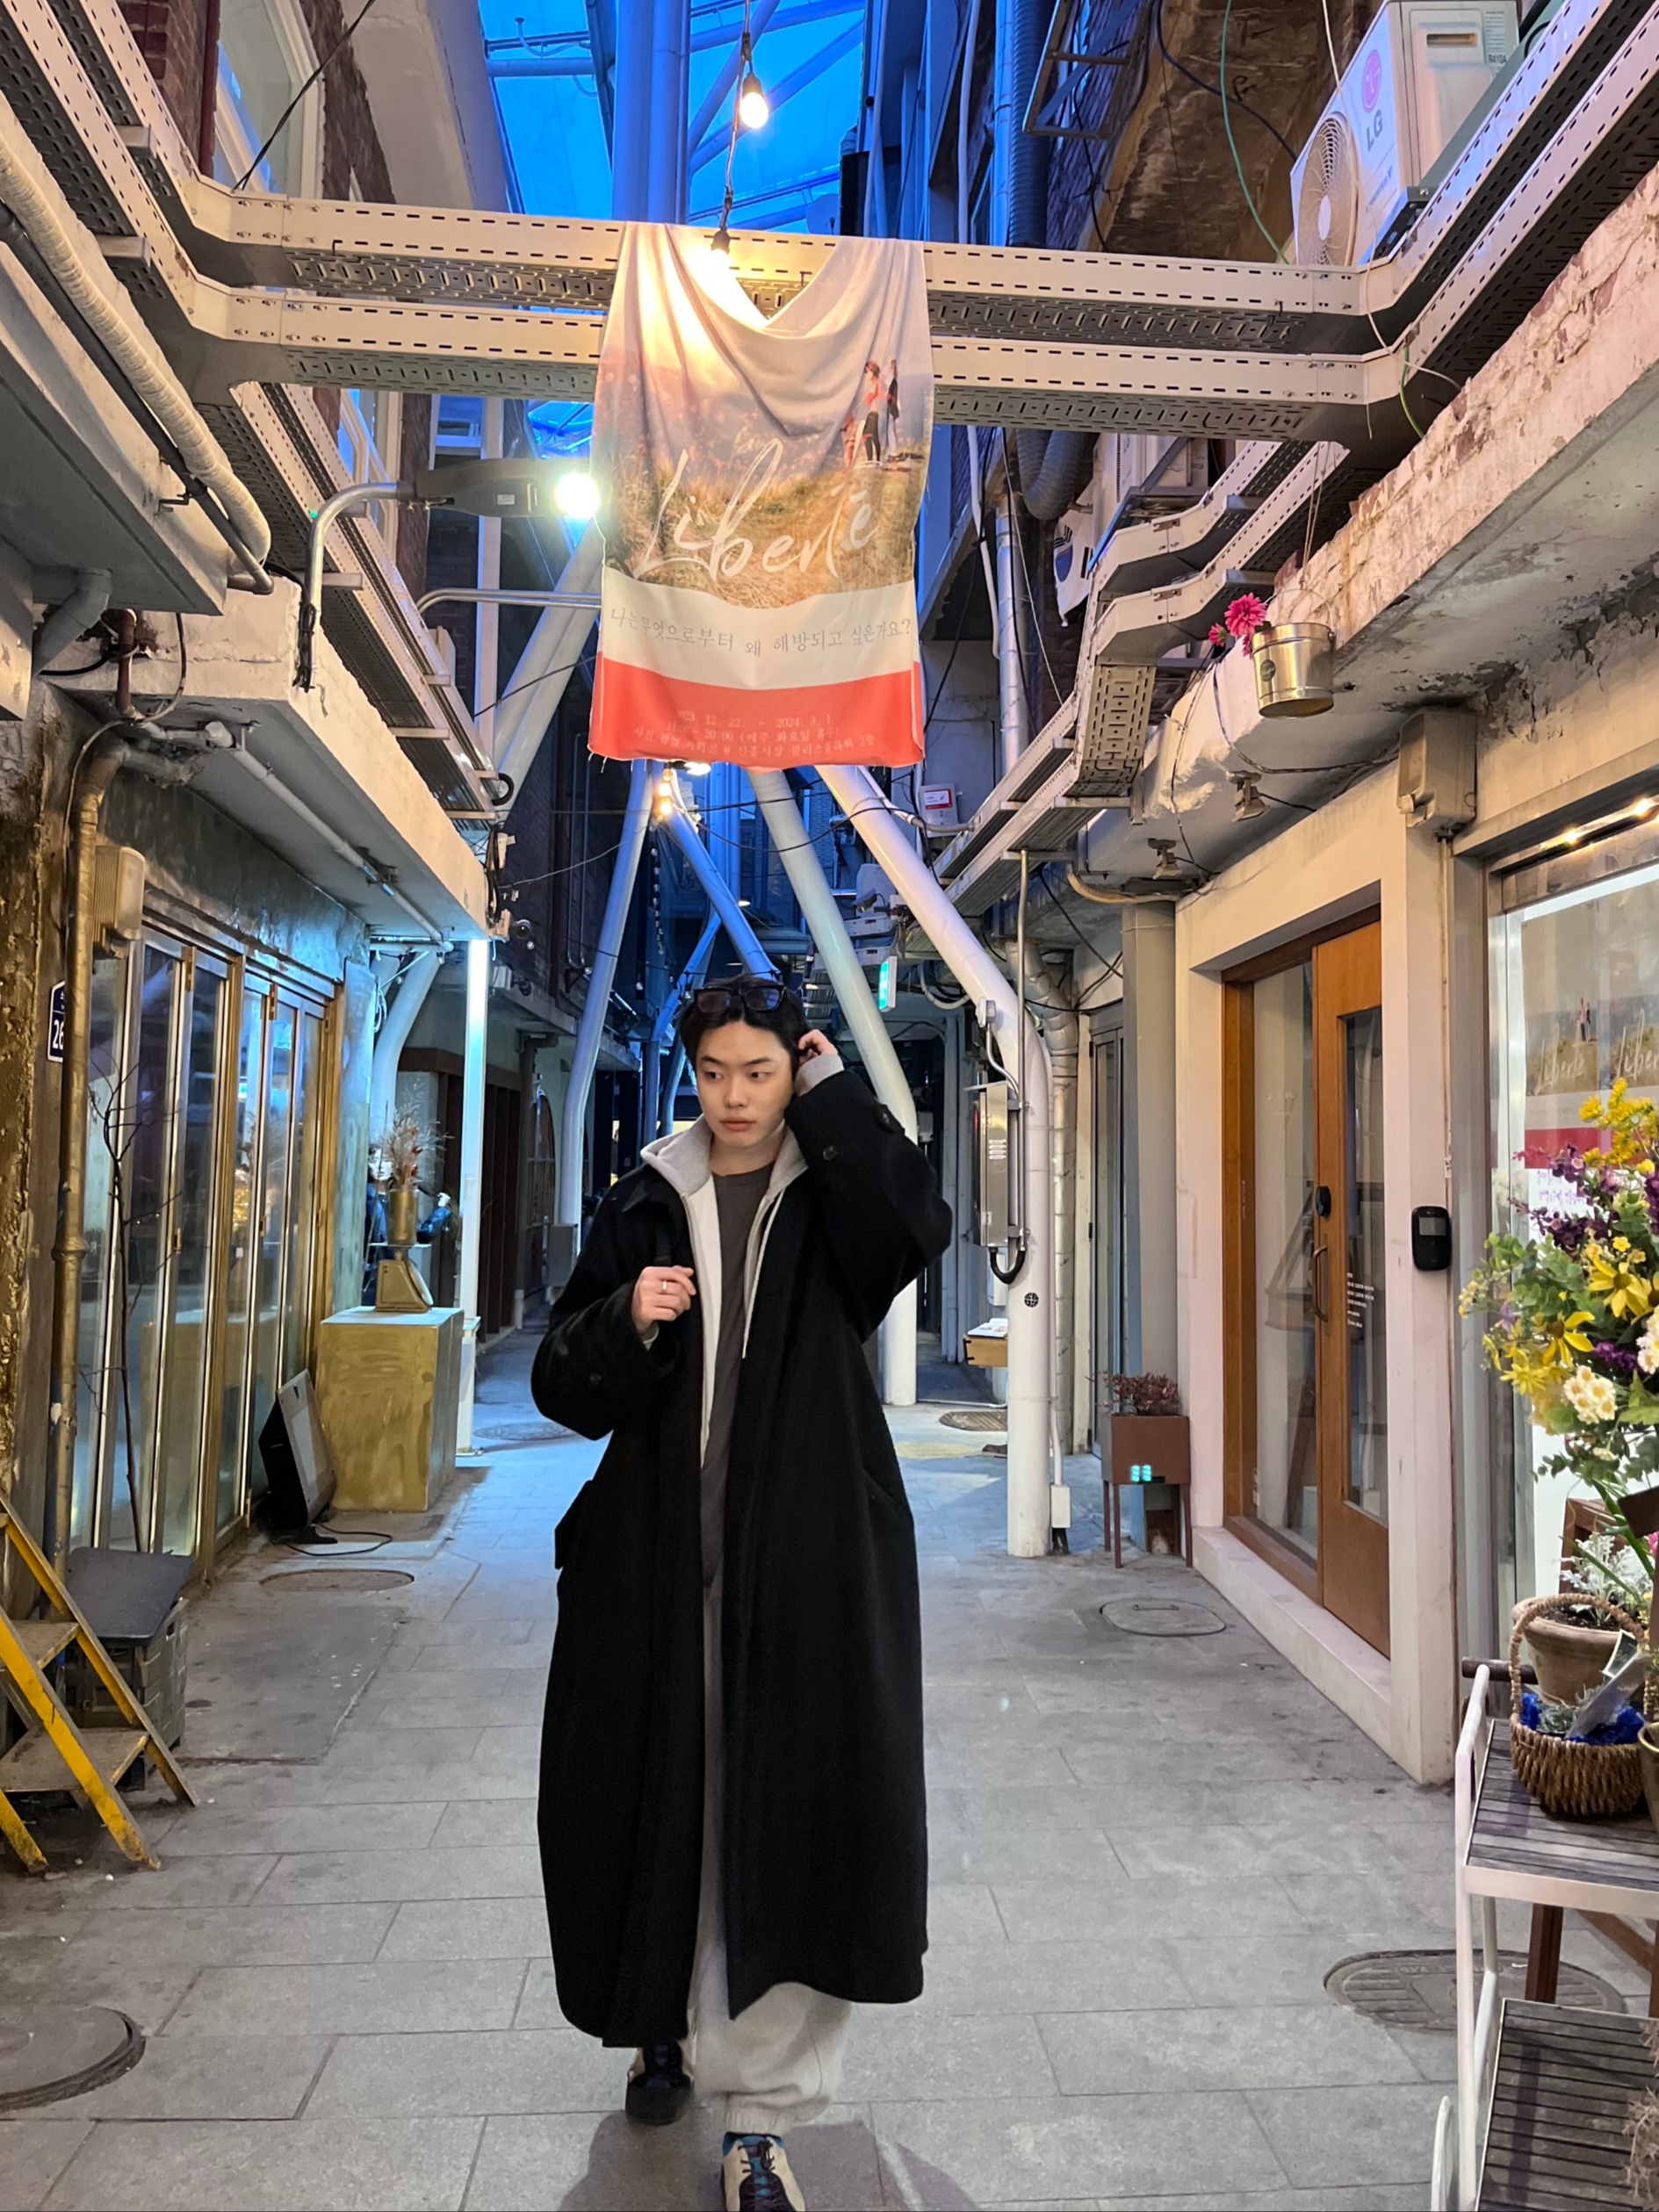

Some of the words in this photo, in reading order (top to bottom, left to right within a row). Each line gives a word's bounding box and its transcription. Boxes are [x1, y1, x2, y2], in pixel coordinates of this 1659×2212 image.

[1366, 109, 1383, 153] LG
[745, 640, 761, 658] 왜
[773, 629, 843, 653] 해방되고
[851, 617, 912, 647] 싶은가요?
